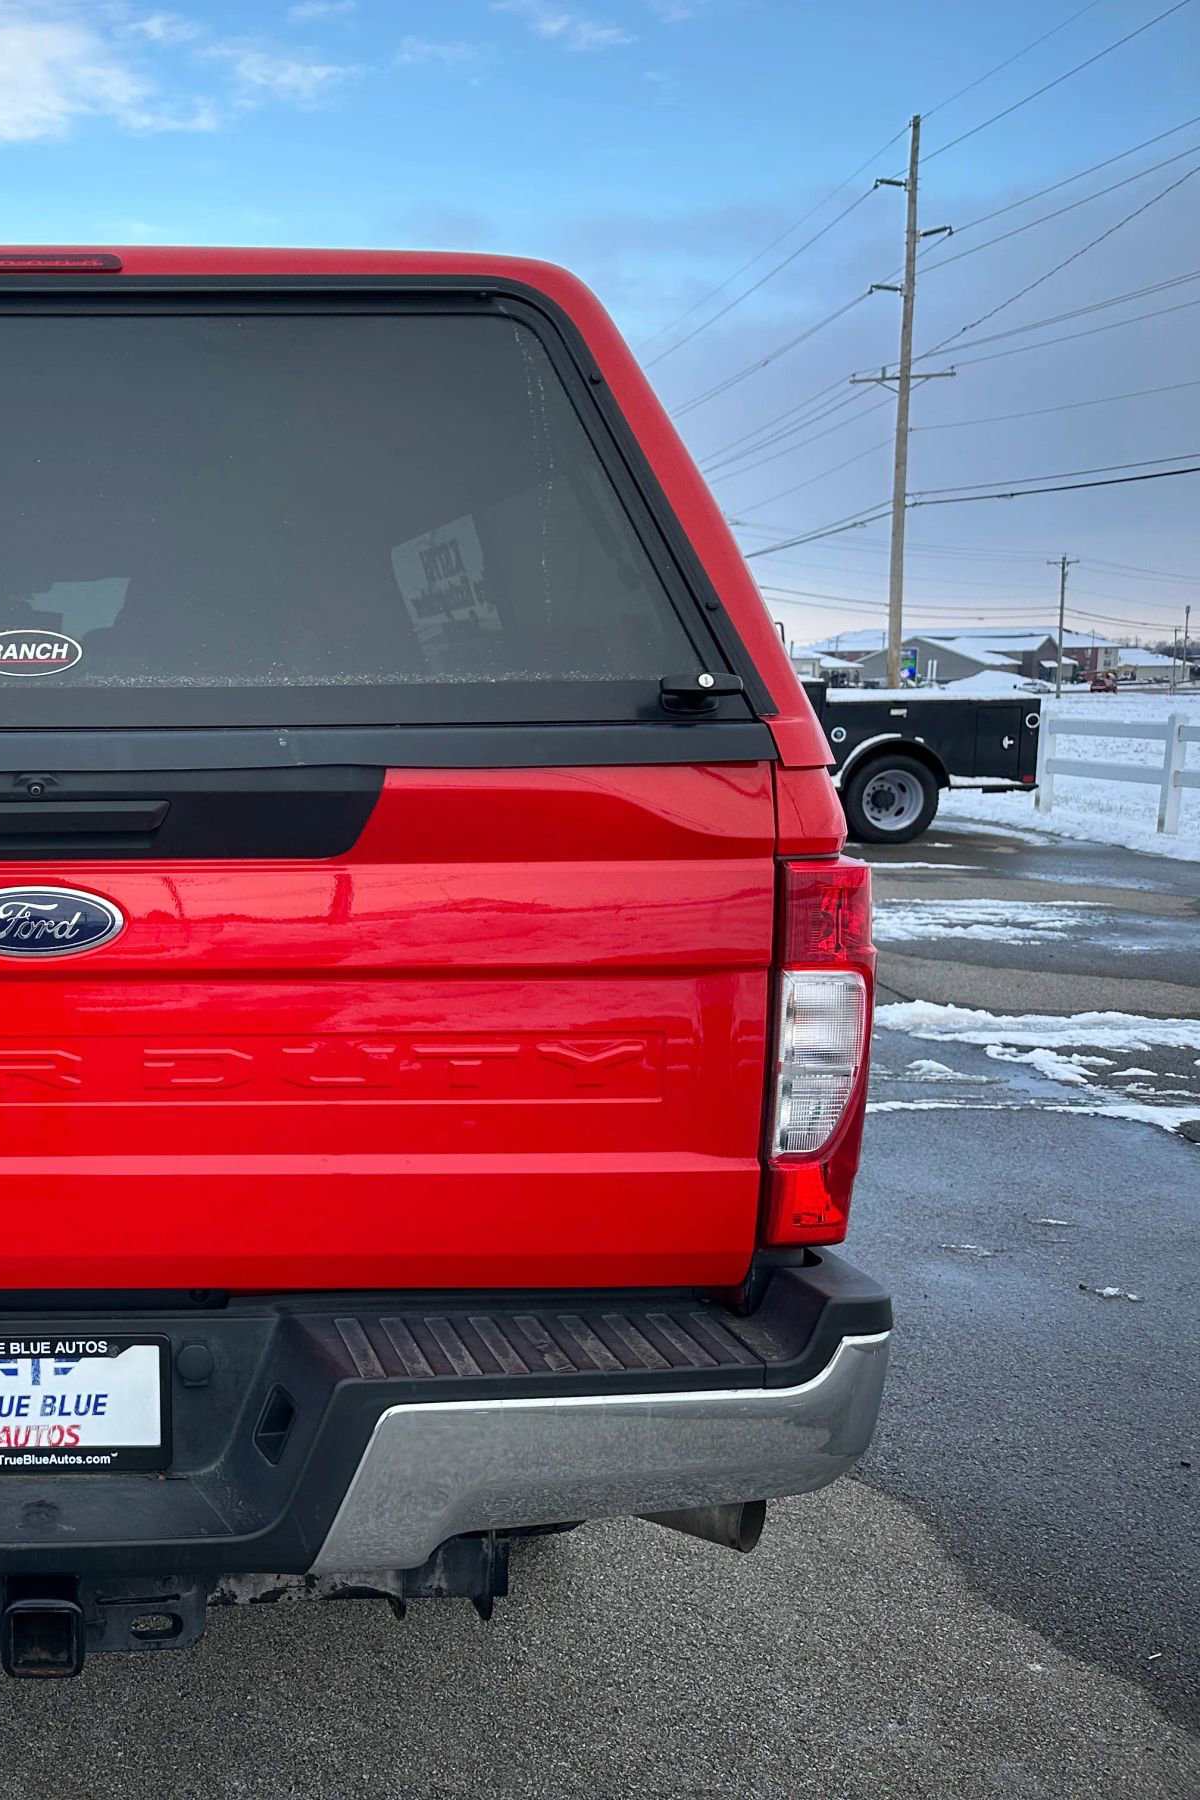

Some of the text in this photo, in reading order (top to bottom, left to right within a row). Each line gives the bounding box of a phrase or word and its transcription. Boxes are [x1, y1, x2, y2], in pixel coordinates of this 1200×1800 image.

[143, 1041, 644, 1089] DUTY
[9, 1341, 51, 1355] BLUE
[54, 1341, 108, 1354] AUTOS
[40, 1394, 109, 1417] BLUE
